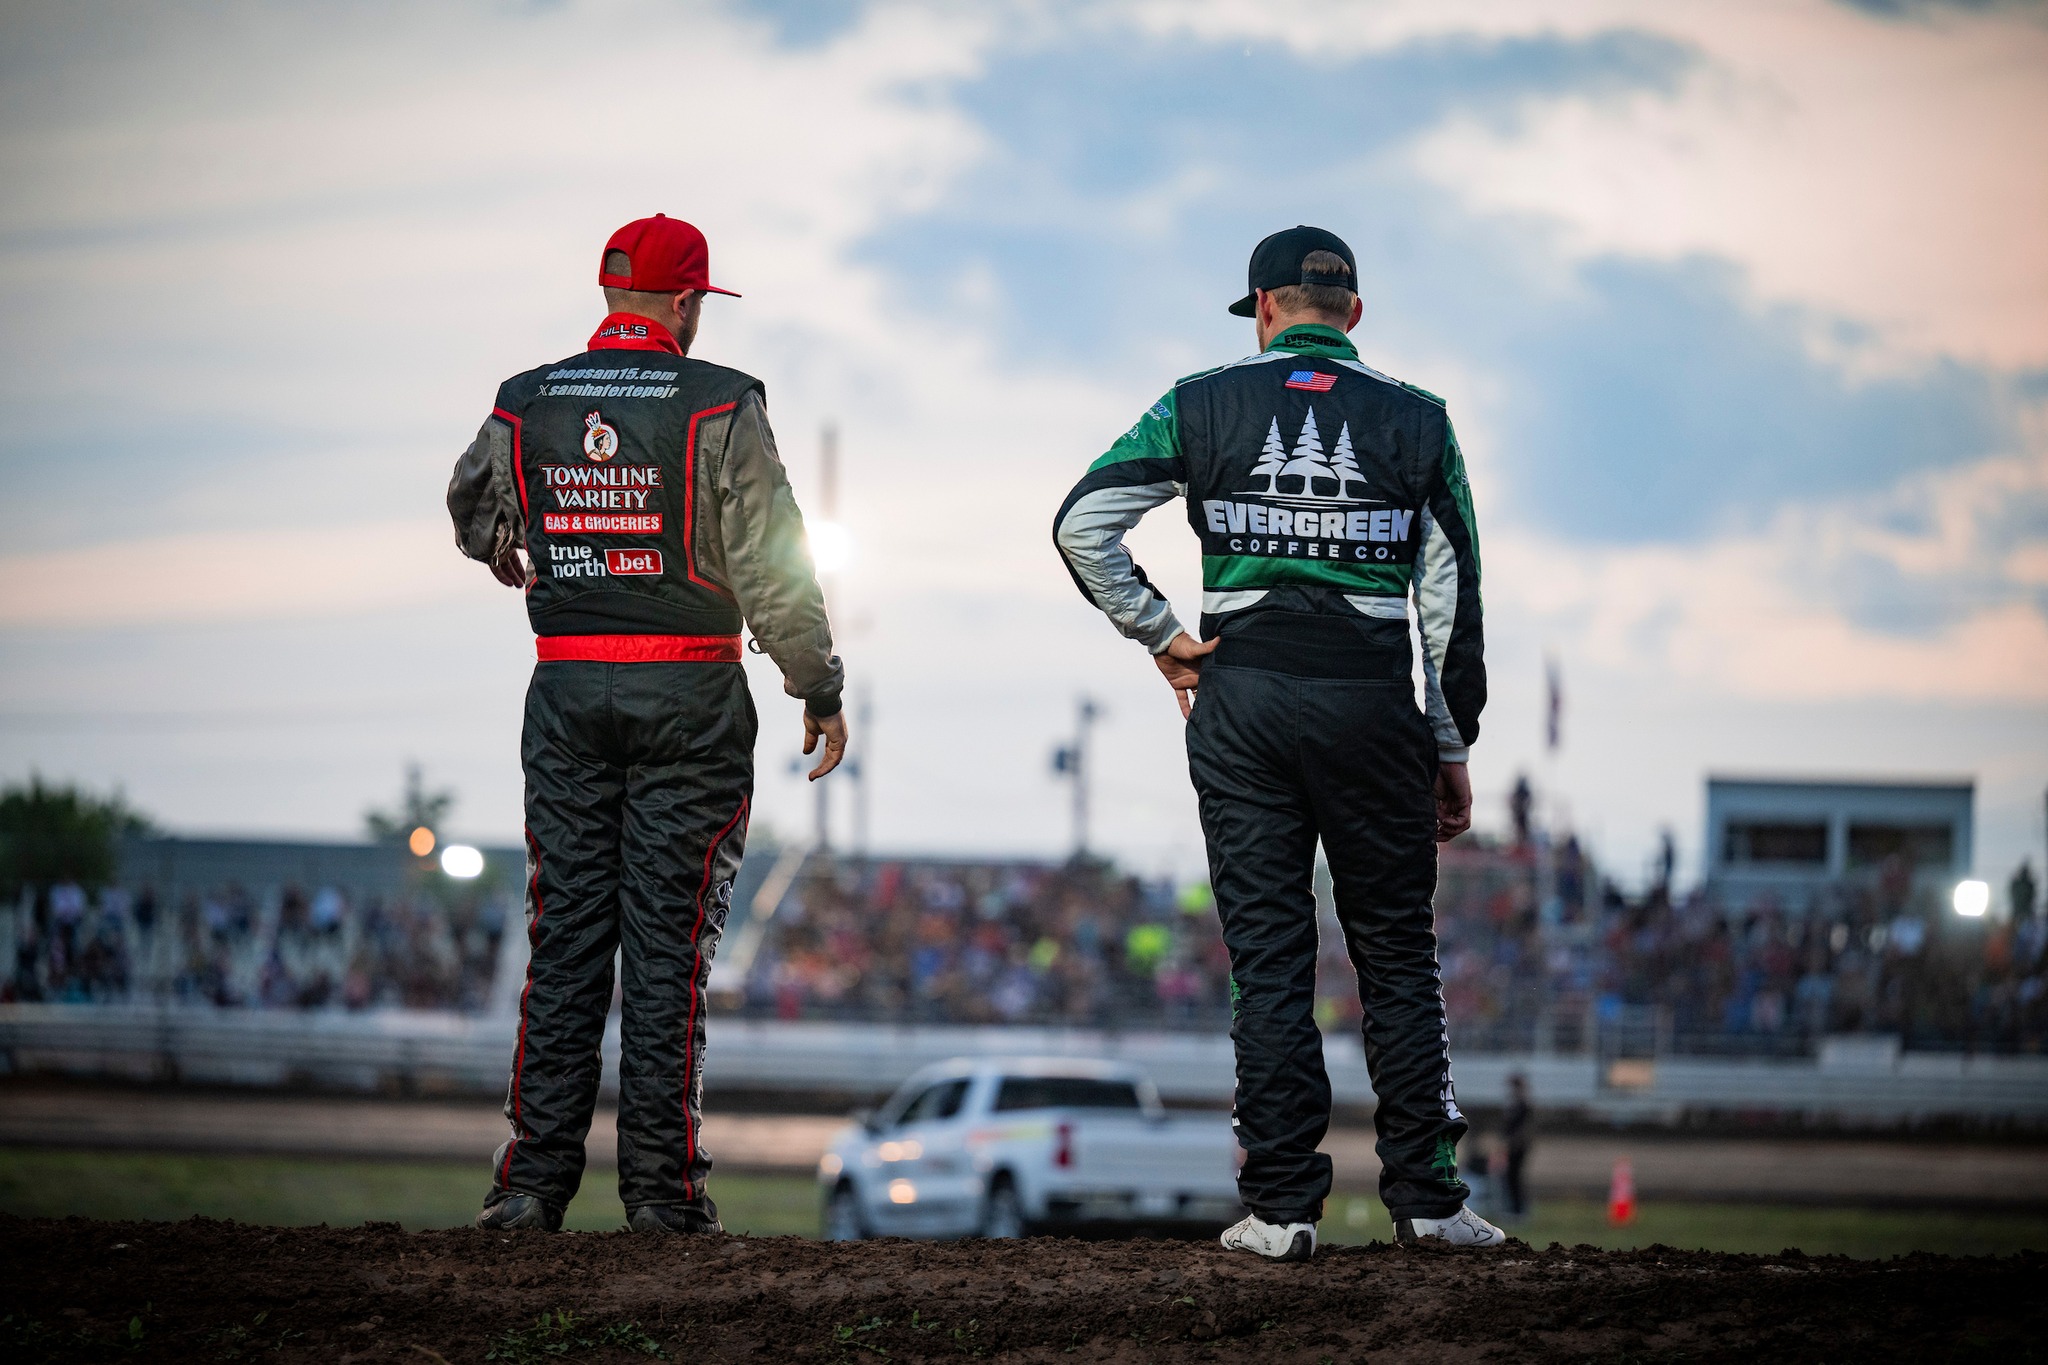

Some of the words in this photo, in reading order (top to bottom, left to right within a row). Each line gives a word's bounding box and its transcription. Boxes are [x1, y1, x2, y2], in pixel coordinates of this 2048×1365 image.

[599, 324, 648, 338] HILL'S
[546, 368, 678, 381] shopsam15.com
[541, 466, 661, 487] TOWNLINE
[555, 488, 649, 508] VARIETY
[545, 516, 569, 530] GAS
[571, 516, 582, 530] &
[585, 516, 660, 530] GROCERIES
[1202, 500, 1414, 542] EVERGREEN
[549, 544, 592, 560] true
[1230, 538, 1340, 558] COFFEE
[1355, 546, 1396, 560] CO.
[552, 558, 606, 578] north
[615, 552, 654, 571] .bet
